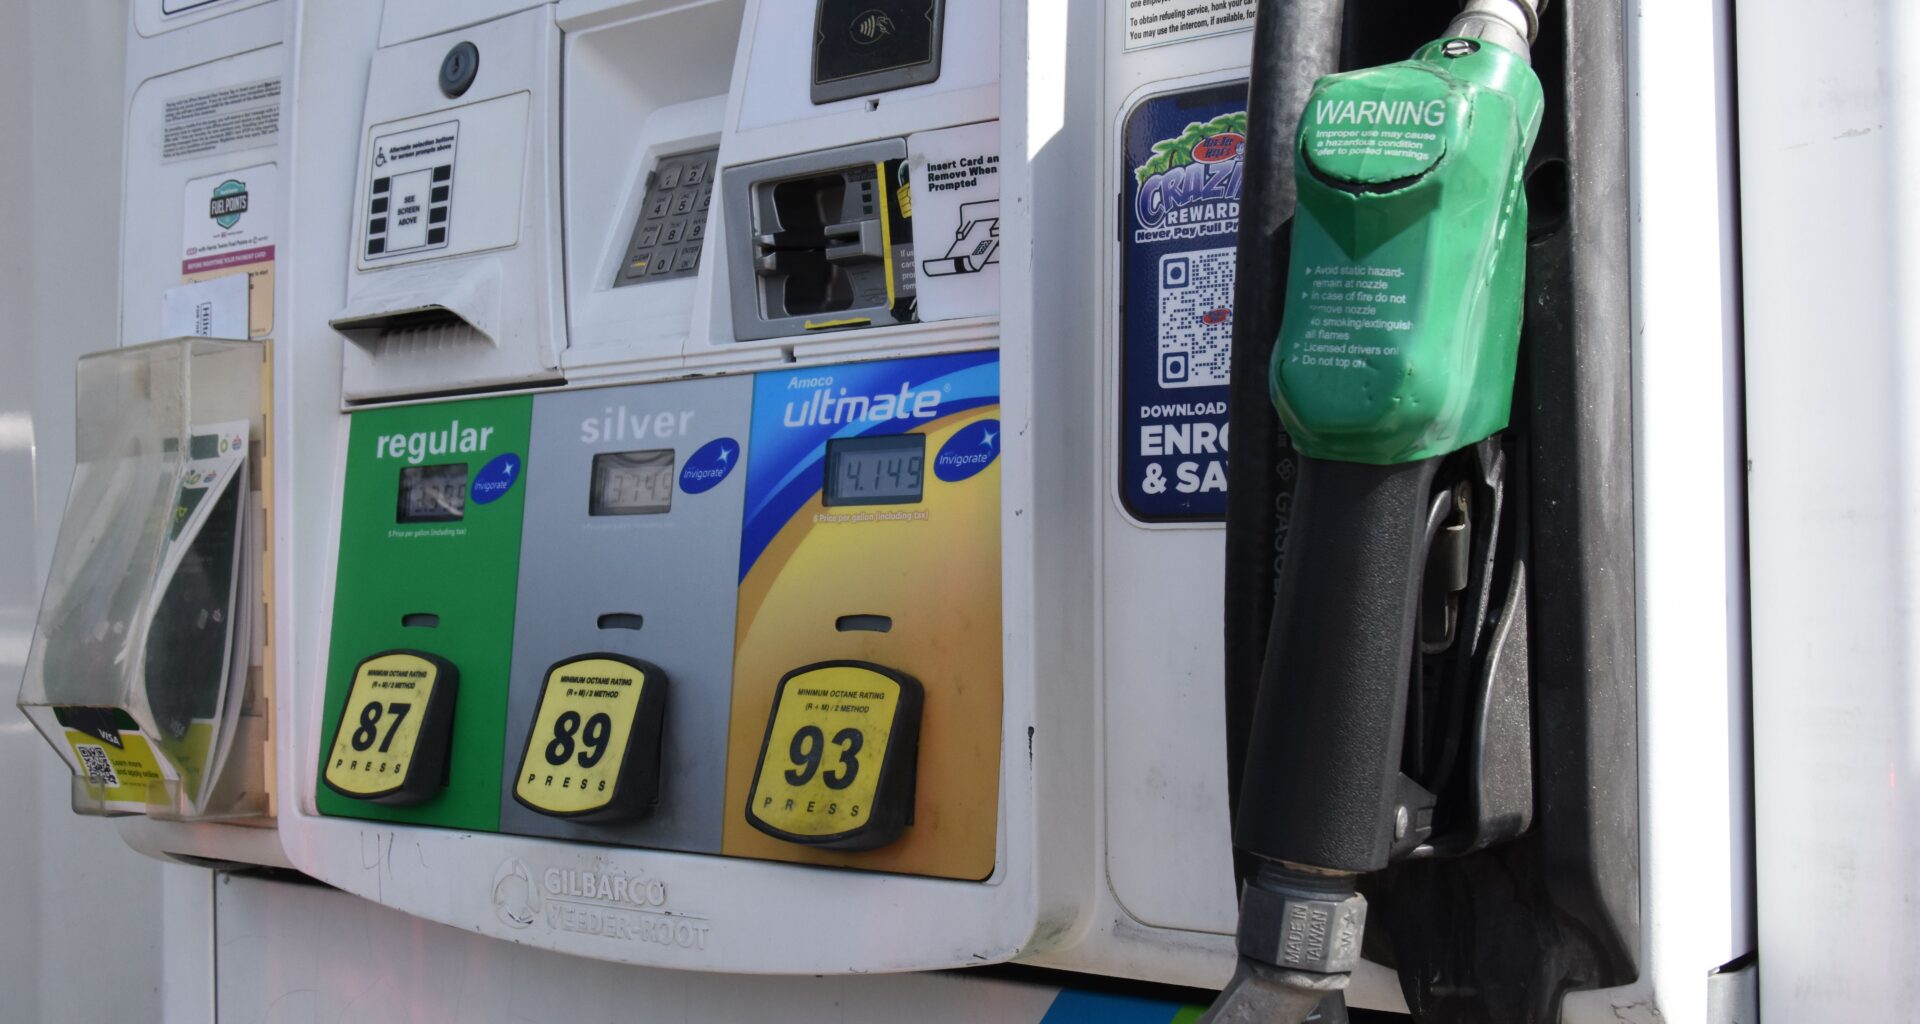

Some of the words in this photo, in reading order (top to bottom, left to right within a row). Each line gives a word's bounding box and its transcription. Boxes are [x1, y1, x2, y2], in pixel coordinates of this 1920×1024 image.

[1131, 18, 1138, 26] To
[1139, 14, 1158, 25] obtain
[1160, 10, 1186, 21] refueling
[1187, 5, 1210, 15] service,
[1211, 2, 1226, 11] honk
[1228, 0, 1242, 10] your
[1130, 31, 1141, 40] You
[1143, 28, 1156, 38] may
[1157, 27, 1167, 35] use
[1169, 23, 1179, 32] the
[1180, 20, 1209, 30] intercom,
[1216, 11, 1245, 24] available,
[1246, 9, 1255, 19] for
[1316, 100, 1445, 126] WARNING
[1316, 130, 1359, 139] Improper
[1381, 131, 1405, 139] may
[1405, 132, 1436, 140] cause
[389, 144, 411, 153] Alternate
[412, 140, 434, 149] selection
[435, 136, 454, 144] buttons
[398, 151, 415, 159] screen
[415, 147, 436, 157] prompts
[437, 144, 451, 152] above
[1378, 140, 1423, 149] condition
[1349, 147, 1381, 156] posted
[1384, 149, 1429, 161] warnings
[927, 161, 956, 172] Insert
[960, 156, 984, 167] Card
[987, 155, 1000, 163] an
[689, 171, 697, 182] 2
[928, 171, 966, 182] Remove
[969, 166, 997, 176] When
[929, 177, 977, 192] Prompted
[211, 200, 225, 215] FUEL
[225, 195, 247, 212] POINTS
[404, 195, 415, 204] SEE
[654, 204, 662, 214] 4
[678, 200, 687, 210] 5
[397, 205, 420, 215] SCREEN
[398, 216, 417, 226] ABOVE
[668, 230, 676, 240] 8
[693, 225, 701, 236] 9
[1137, 229, 1171, 240] Never
[1174, 227, 1197, 238] Pay
[1200, 223, 1221, 234] Full
[657, 260, 665, 270] 0
[1314, 266, 1338, 275] Avoid
[1340, 266, 1366, 275] static
[1313, 279, 1342, 288] remain
[1355, 280, 1388, 290] nozzle
[1345, 291, 1356, 301] of
[1356, 291, 1373, 302] fire
[1375, 292, 1388, 302] do
[1390, 294, 1406, 304] not
[1345, 305, 1376, 315] nozzle
[1318, 330, 1350, 340] flames
[1303, 342, 1346, 353] Licensed
[1348, 344, 1381, 355] drivers
[1302, 354, 1316, 365] Do
[1318, 358, 1333, 366] not
[1336, 357, 1350, 369] top
[787, 376, 833, 390] Amoco
[1141, 402, 1227, 418] DOWNLOAD
[580, 405, 695, 444] silver
[376, 419, 493, 464] regular
[939, 453, 988, 467] Invigorate
[684, 466, 724, 480] Invigorate
[847, 456, 922, 491] 4.149
[1142, 462, 1167, 494] &
[474, 480, 508, 492] Invigorate
[819, 513, 837, 522] Price
[838, 514, 849, 523] per
[851, 512, 874, 523] gallon
[875, 512, 912, 522] (including
[914, 510, 929, 521] tax)
[560, 675, 585, 684] MINIMUM
[586, 676, 610, 685] OCTANE
[610, 678, 633, 686] RATING
[593, 690, 619, 698] METHOD
[830, 690, 858, 698] OCTANE
[859, 692, 885, 700] RATING
[805, 702, 813, 711] (R
[840, 705, 869, 713] METHOD
[352, 701, 412, 753] 87
[98, 728, 121, 746] VISA
[545, 710, 611, 768] 89
[784, 725, 864, 790] 93
[336, 759, 401, 774] PRESS
[528, 774, 606, 791] PRESS
[763, 797, 859, 817] PRESS
[545, 867, 667, 906] GILBARCO
[1292, 904, 1308, 920] IN
[545, 903, 710, 950] VEEDER-ROOT
[1283, 922, 1305, 963] MADE
[1306, 910, 1328, 961] TAIWAN
